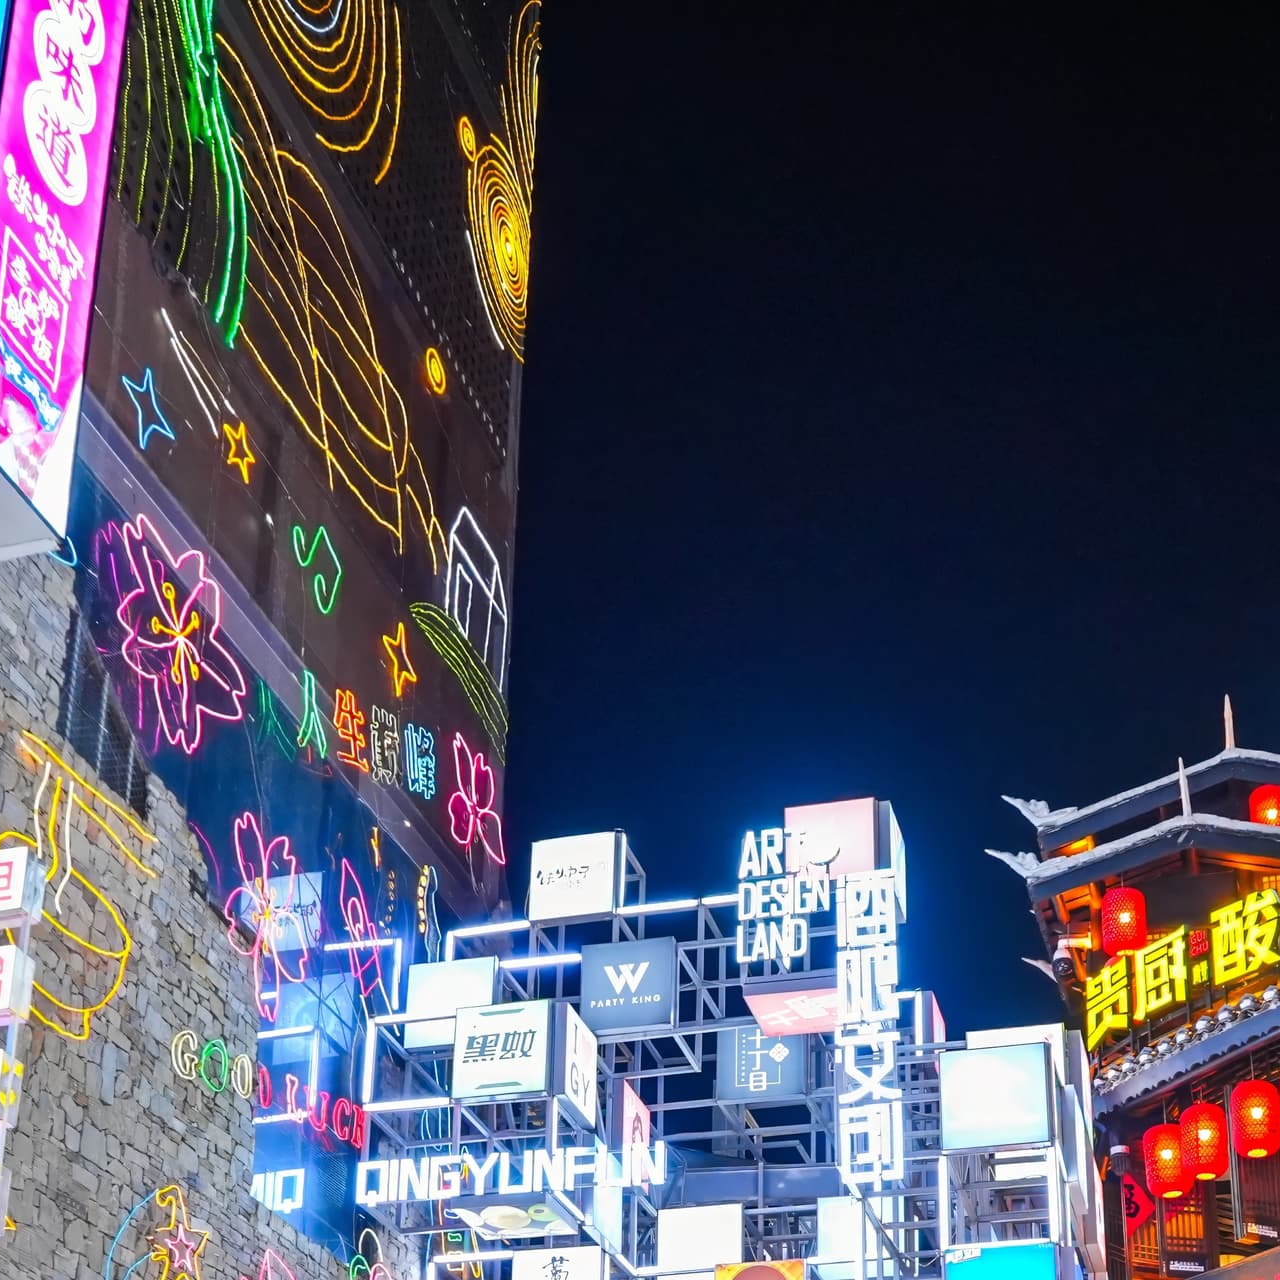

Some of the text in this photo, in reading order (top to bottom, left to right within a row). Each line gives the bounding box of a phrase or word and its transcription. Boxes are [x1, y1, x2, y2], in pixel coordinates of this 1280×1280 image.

[738, 827, 807, 879] ART
[736, 872, 831, 921] DESIGN
[735, 916, 809, 966] LAND
[590, 993, 662, 1009] PARTY KING
[1086, 924, 1187, 1053] 贵厨
[286, 1073, 366, 1149] LUCK
[356, 1147, 567, 1207] QINGYUN
